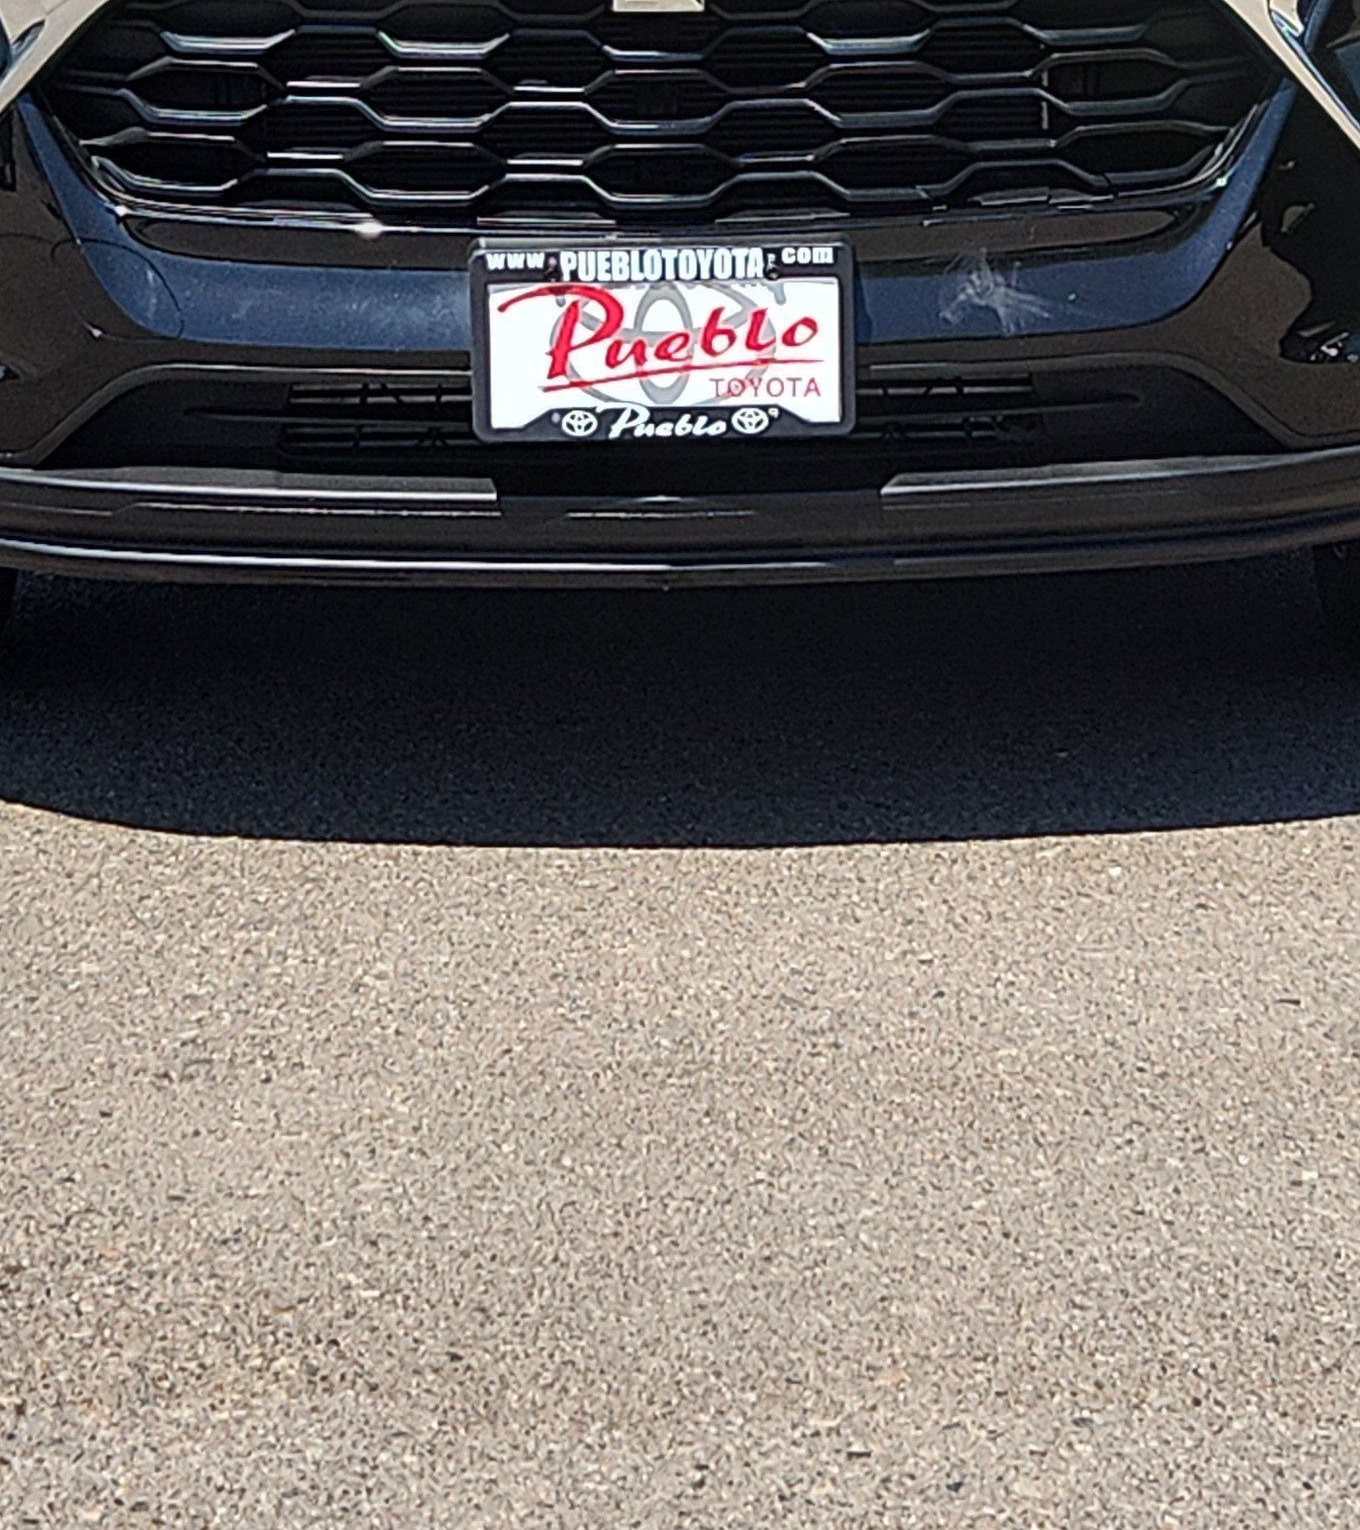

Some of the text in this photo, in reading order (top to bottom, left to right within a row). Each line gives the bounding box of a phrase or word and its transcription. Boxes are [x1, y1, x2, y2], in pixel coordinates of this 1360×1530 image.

[497, 284, 819, 379] Pueblo
[709, 377, 822, 398] TOYOTA
[596, 406, 727, 439] Pueblo
